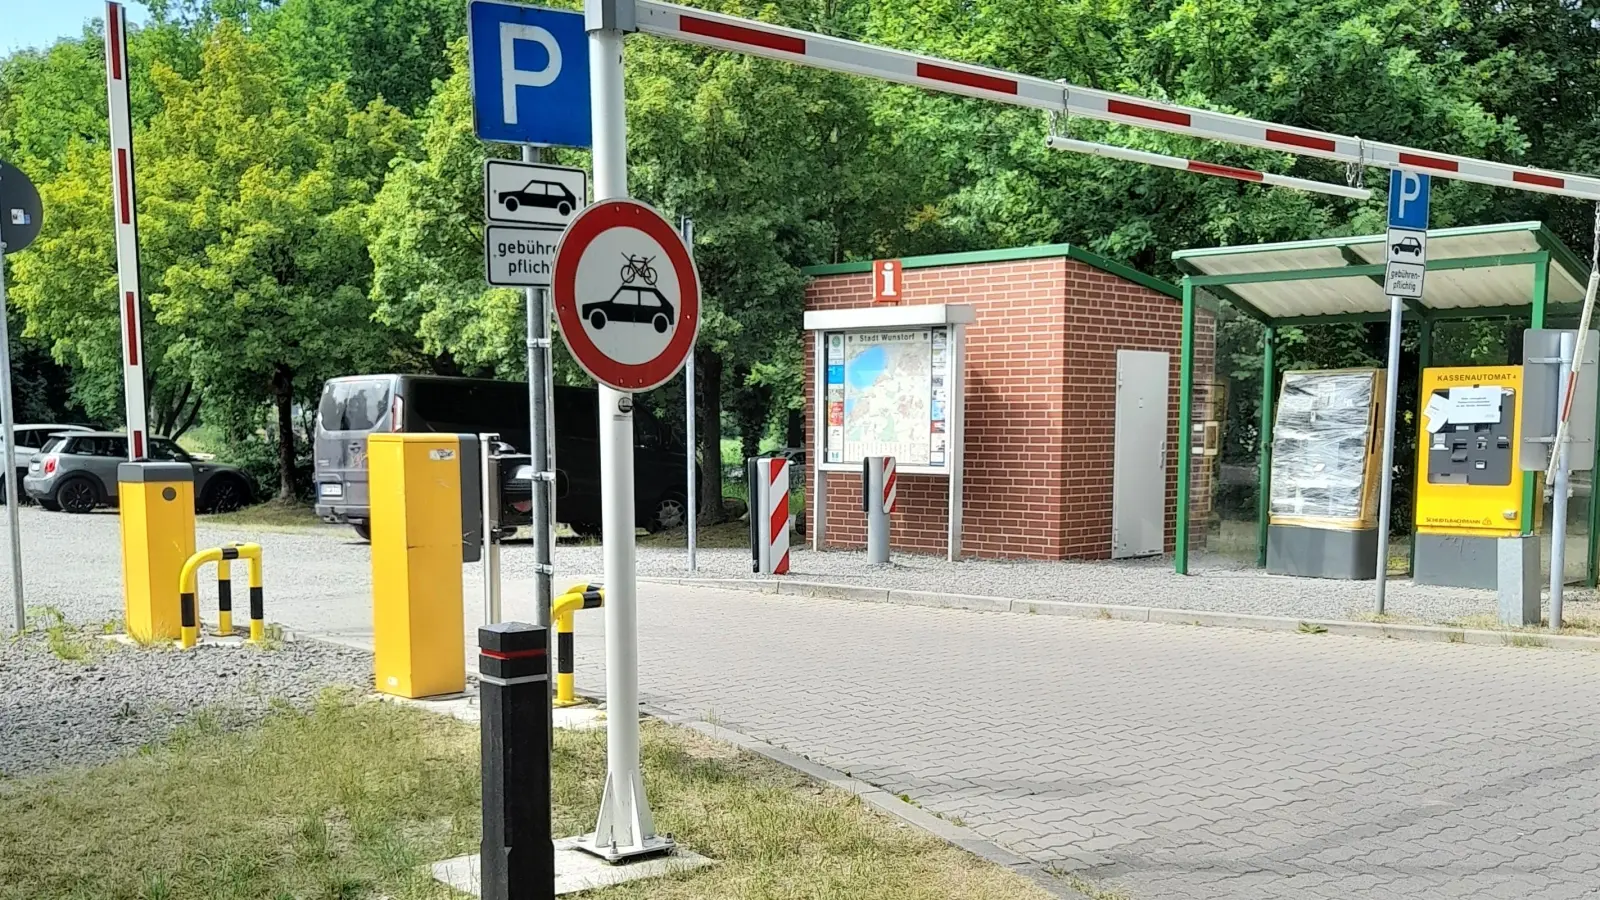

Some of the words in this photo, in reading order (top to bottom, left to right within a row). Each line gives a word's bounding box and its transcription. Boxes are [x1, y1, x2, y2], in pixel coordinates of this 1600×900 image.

[499, 21, 563, 125] P
[1398, 170, 1421, 218] P
[508, 255, 553, 277] pflich
[880, 261, 898, 297] i
[859, 334, 879, 343] Stadt
[881, 332, 915, 342] Wunstorf
[1437, 373, 1511, 382] KASSENAUTOMAT
